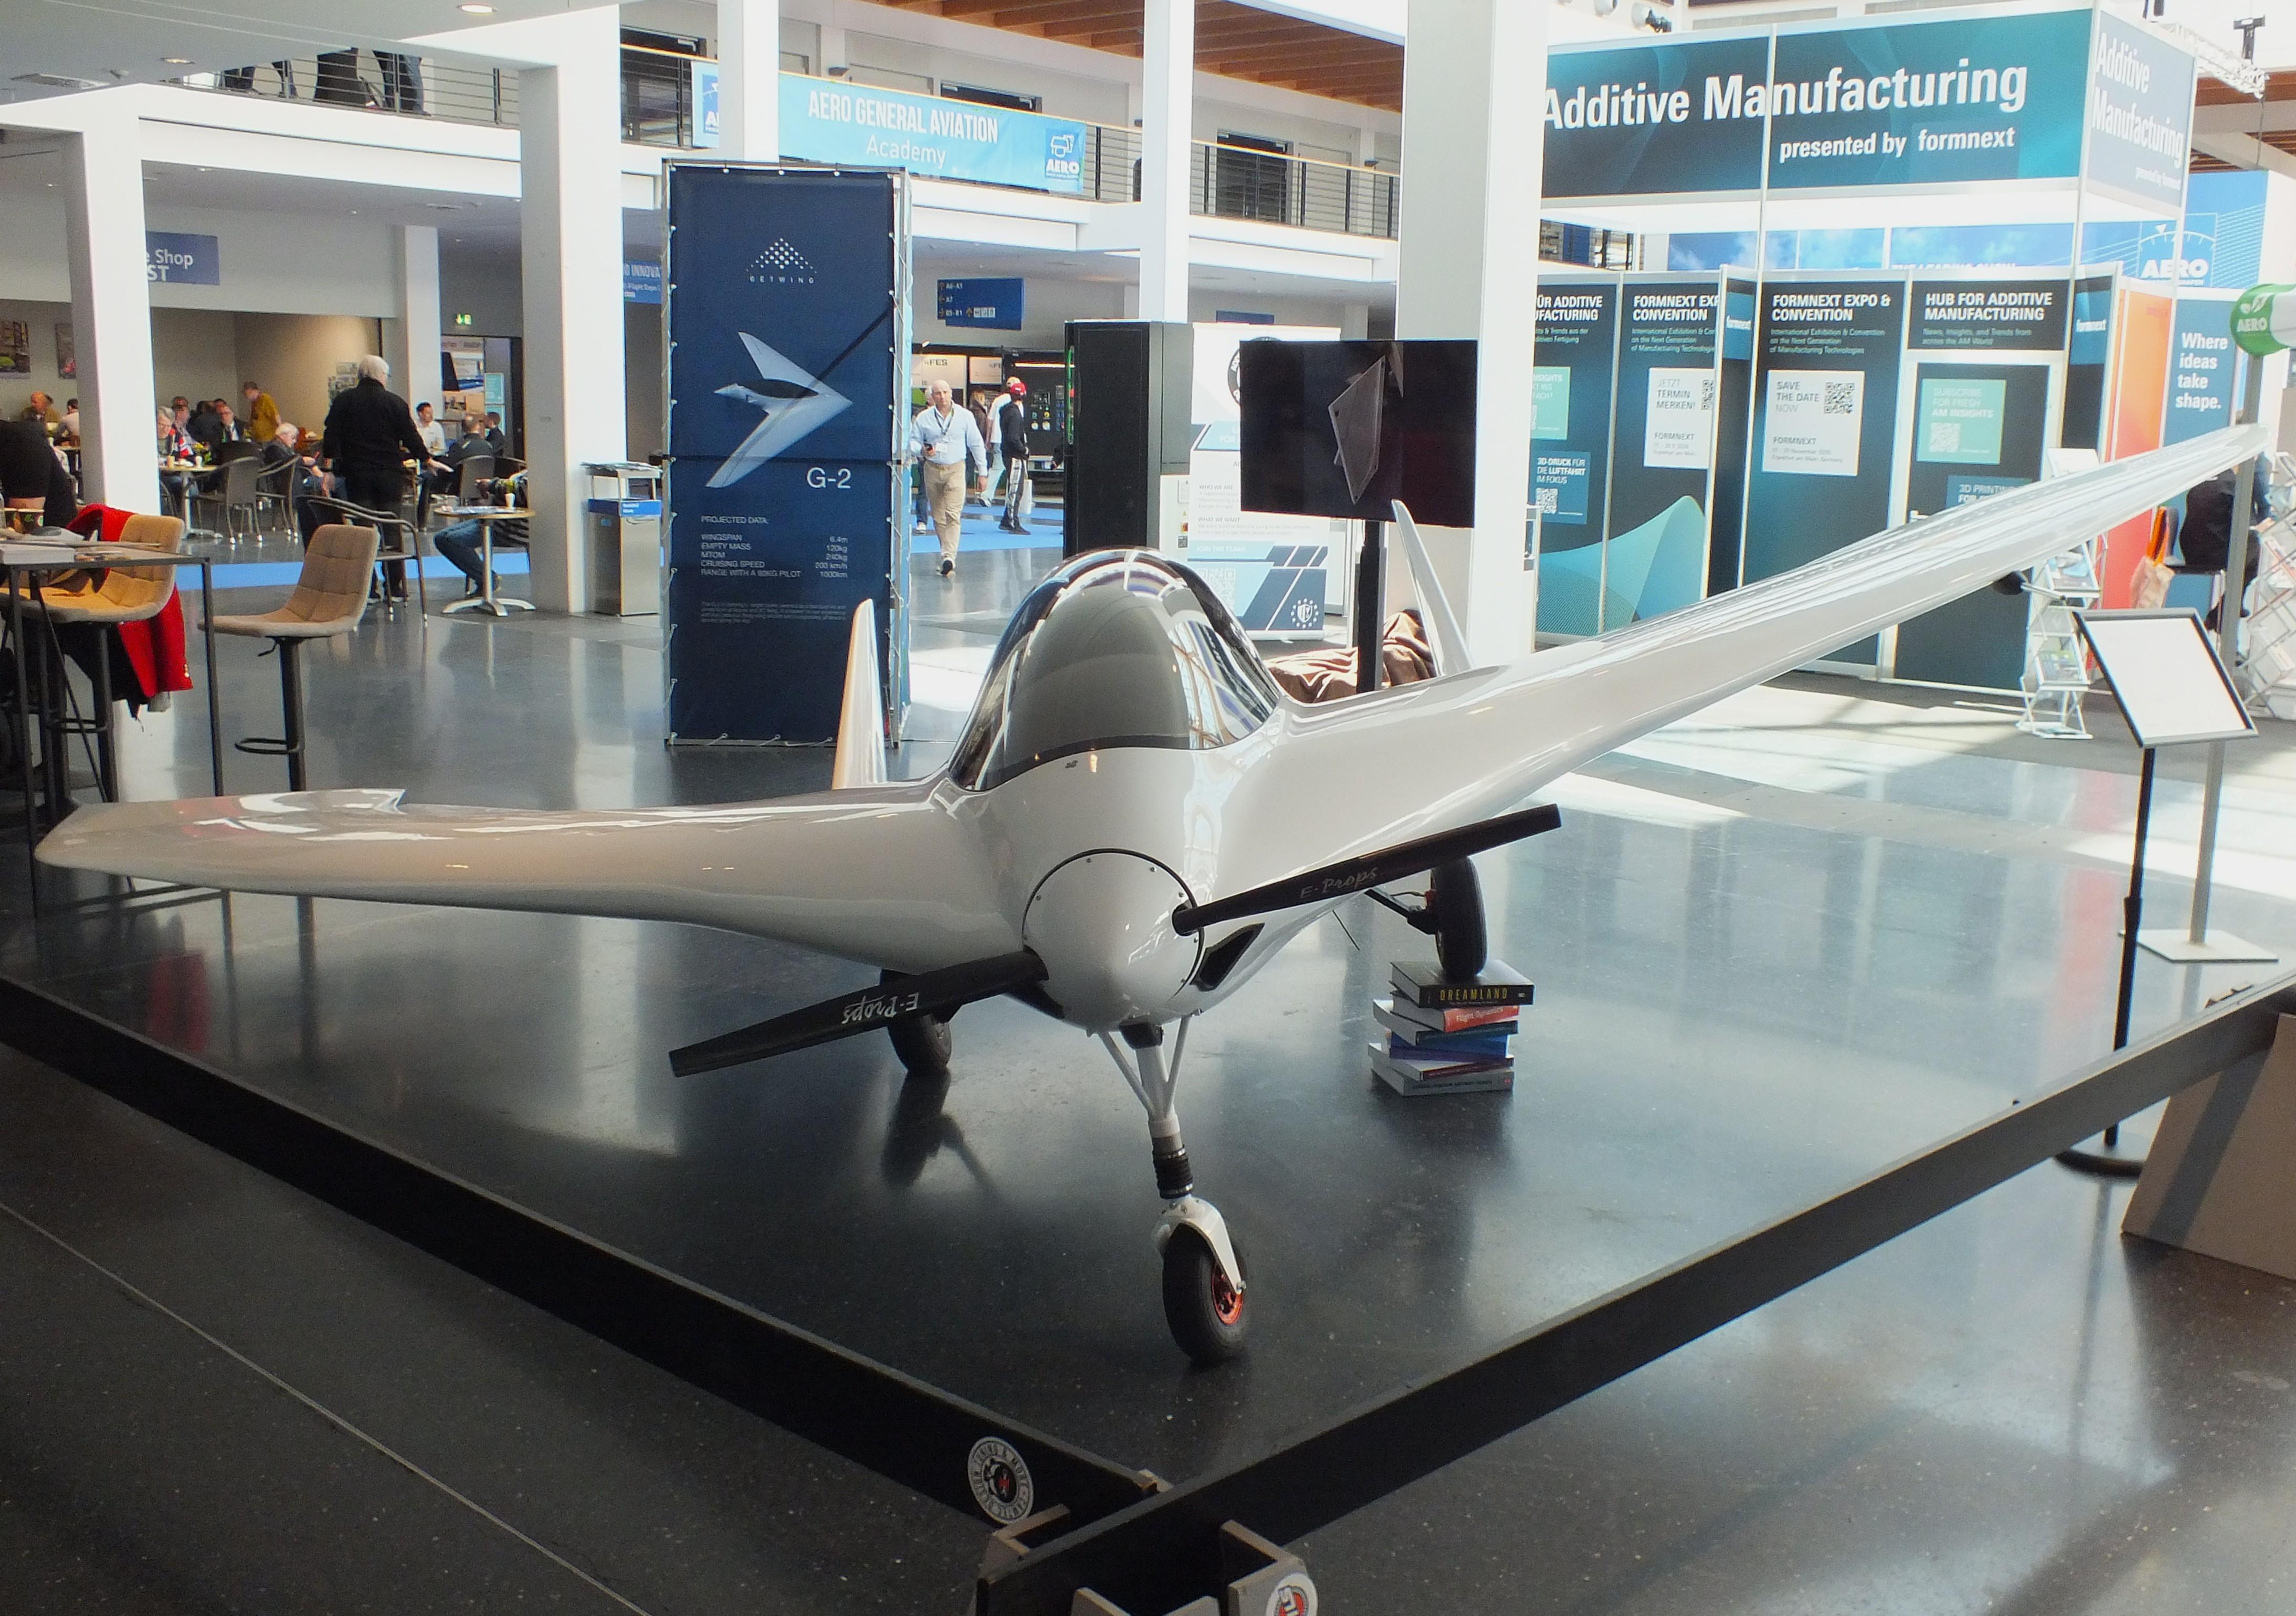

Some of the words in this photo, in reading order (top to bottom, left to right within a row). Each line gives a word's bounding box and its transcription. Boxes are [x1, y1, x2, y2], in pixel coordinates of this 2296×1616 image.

[2096, 32, 2152, 95] Additive
[1544, 82, 1690, 130] Additive
[1703, 58, 2027, 121] Manufacturing
[808, 90, 851, 122] AERO
[855, 98, 927, 133] GENERAL
[930, 109, 998, 143] AVIATION
[2091, 88, 2185, 169] Manufacturing
[865, 134, 946, 169] Academy
[1779, 132, 1876, 163] presented
[1882, 132, 1906, 158] by
[1918, 127, 2016, 152] formnext
[1046, 159, 1080, 174] AERO
[155, 248, 194, 269] Shop
[2141, 258, 2208, 279] AERO
[1537, 294, 1551, 308] ÜR
[1553, 295, 1603, 308] ADDITIVE
[1633, 295, 1697, 308] FORMNEXT
[1772, 294, 1842, 308] FORMNEXT
[1843, 293, 1878, 308] EXPO
[1880, 294, 1891, 308] &
[1925, 292, 1955, 306] HUB
[1958, 292, 1985, 306] FOR
[1987, 292, 2053, 306] ADDITIVE
[1633, 308, 1708, 321] CONVENTION
[1771, 308, 1853, 322] CONVENTION
[1924, 307, 2044, 321] MANUFACTURING
[2237, 317, 2268, 332] AERO
[2182, 332, 2229, 350] Where
[2179, 353, 2218, 370] ideas
[1657, 379, 1680, 387] JETZT
[1777, 381, 1801, 390] SAVE
[2177, 373, 2209, 389] take
[1656, 390, 1691, 398] TERMIN
[1776, 393, 1794, 402] THE
[1796, 393, 1820, 402] DATE
[1656, 401, 1696, 410] MERKEN!
[1775, 404, 1798, 413] NOW
[1537, 457, 1571, 466] 3D-DRUCK
[1572, 458, 1585, 467] FÜR
[807, 467, 851, 489] G-2
[1549, 467, 1586, 476] LUFTFAHRT
[701, 516, 747, 524] PROJECTED
[1440, 988, 1508, 1001] DREAMLAND
